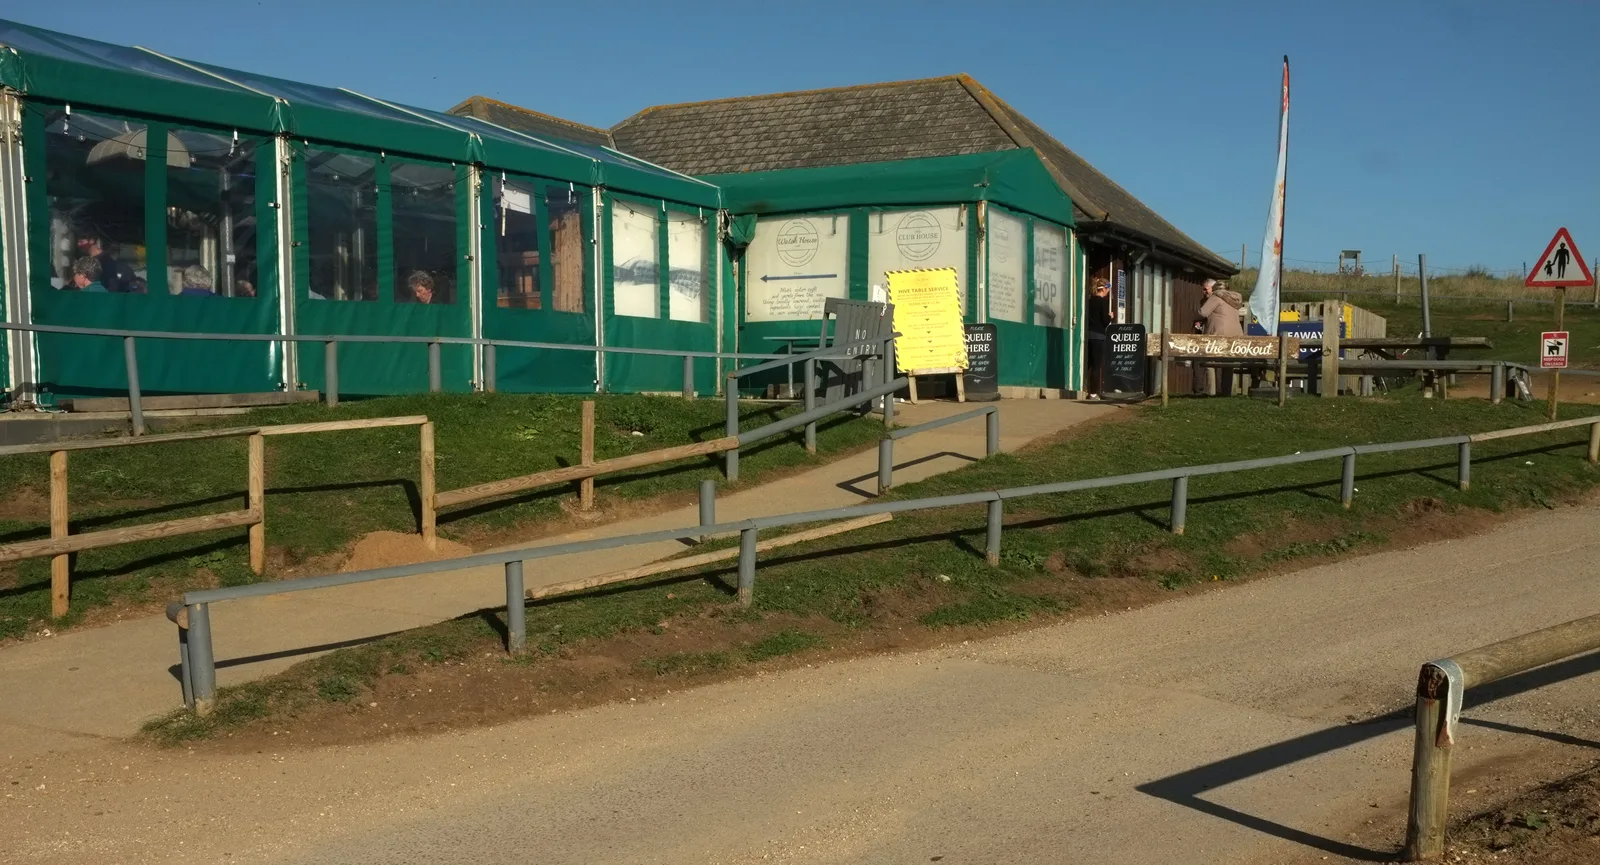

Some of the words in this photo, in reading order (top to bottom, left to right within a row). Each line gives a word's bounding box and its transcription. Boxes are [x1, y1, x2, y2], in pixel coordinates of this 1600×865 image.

[798, 236, 818, 244] House
[916, 232, 939, 240] HOUSE
[1034, 247, 1057, 272] AFÉ
[1034, 281, 1057, 303] HOP
[855, 329, 867, 340] NO
[965, 333, 992, 343] QUEUE
[1110, 333, 1140, 343] QUEUE
[1287, 331, 1323, 340] EAWAY
[846, 344, 877, 356] ENTRY
[966, 344, 990, 353] HERE
[1113, 344, 1138, 353] HERE
[1186, 342, 1200, 354] to
[1205, 340, 1223, 354] the
[1230, 340, 1273, 356] lookout
